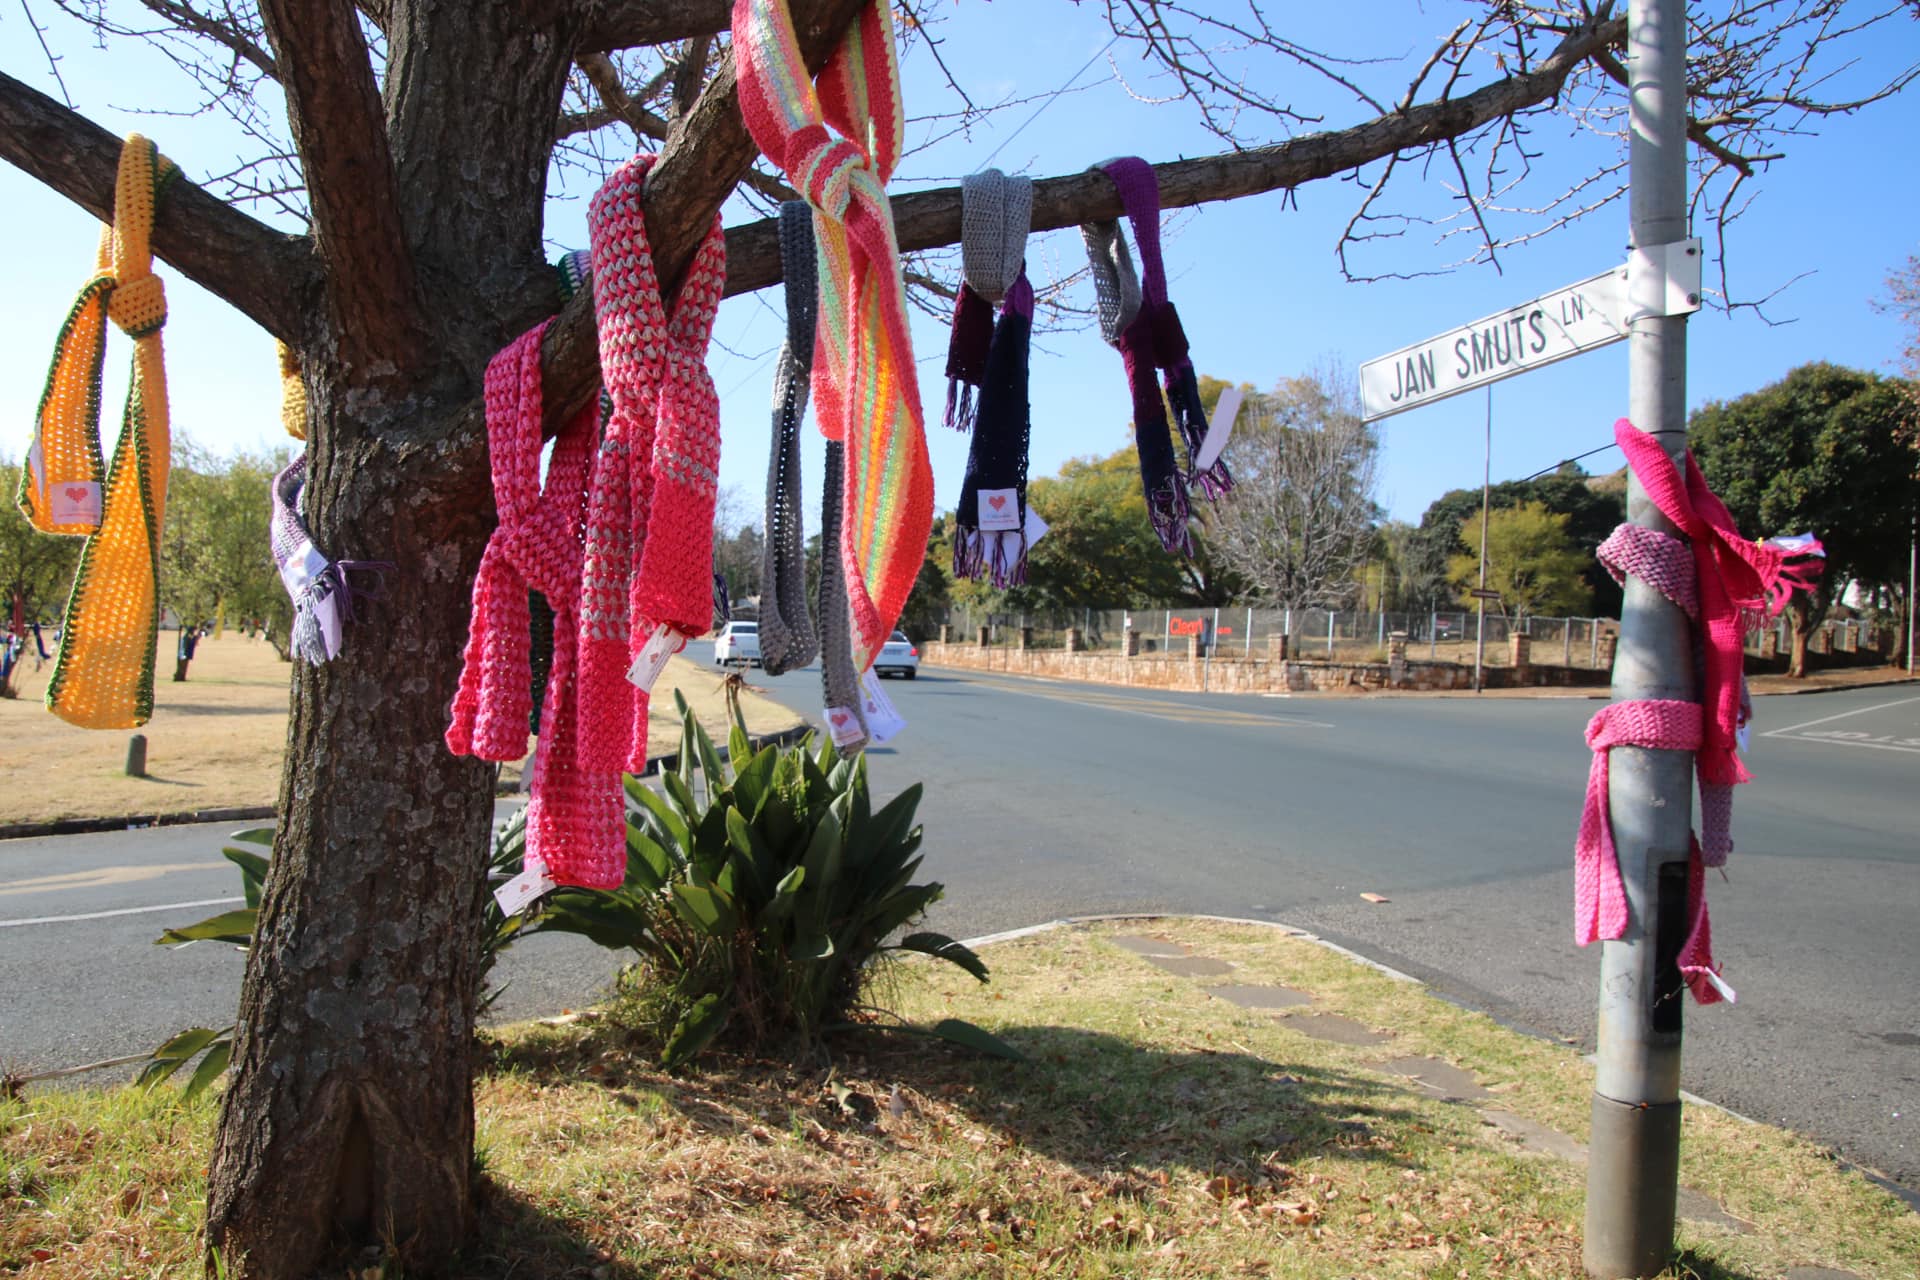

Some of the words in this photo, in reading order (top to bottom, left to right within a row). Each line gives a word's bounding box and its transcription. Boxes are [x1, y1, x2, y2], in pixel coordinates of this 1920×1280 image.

[1390, 349, 1437, 401] JAN
[1455, 310, 1547, 379] SMUTS
[1561, 294, 1584, 326] LN
